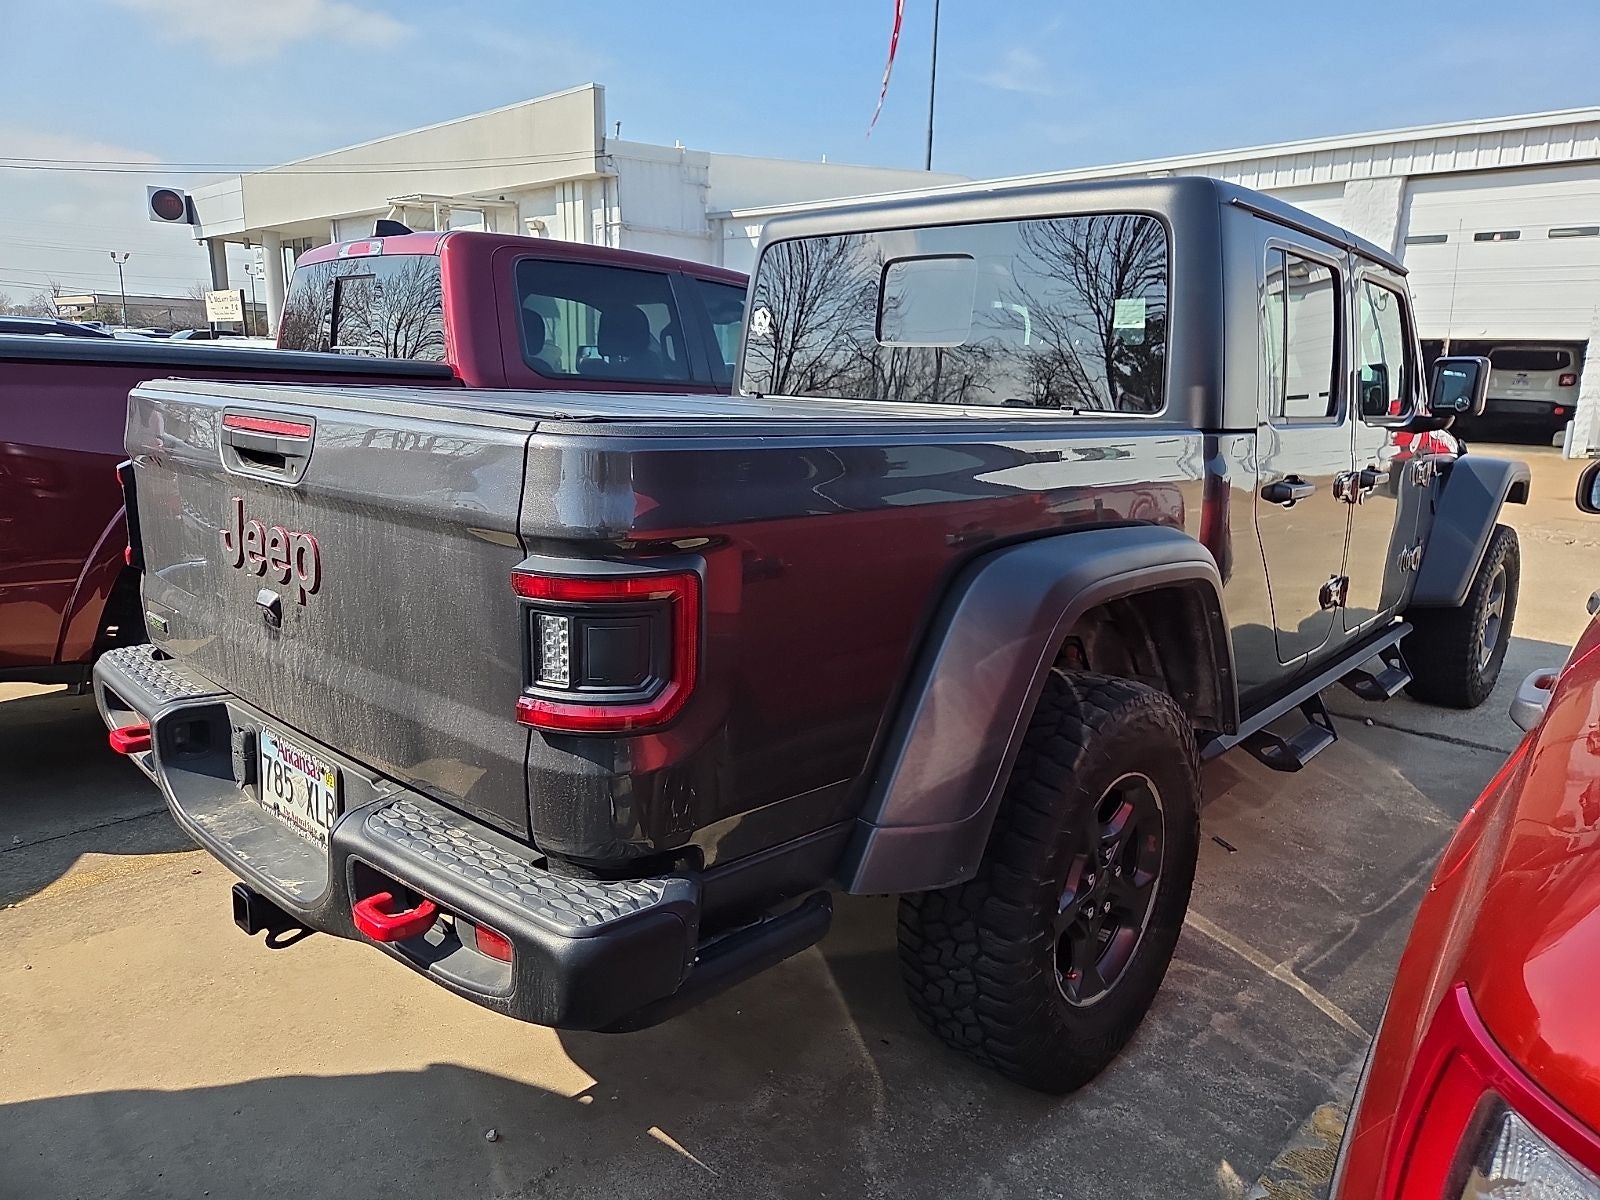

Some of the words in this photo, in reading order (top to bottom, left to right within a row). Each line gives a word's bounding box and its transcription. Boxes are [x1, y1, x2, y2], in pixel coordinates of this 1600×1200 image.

[220, 496, 321, 606] Jeep
[263, 752, 294, 804] 785
[305, 777, 335, 829] XLB
[277, 741, 321, 782] Arkansas
